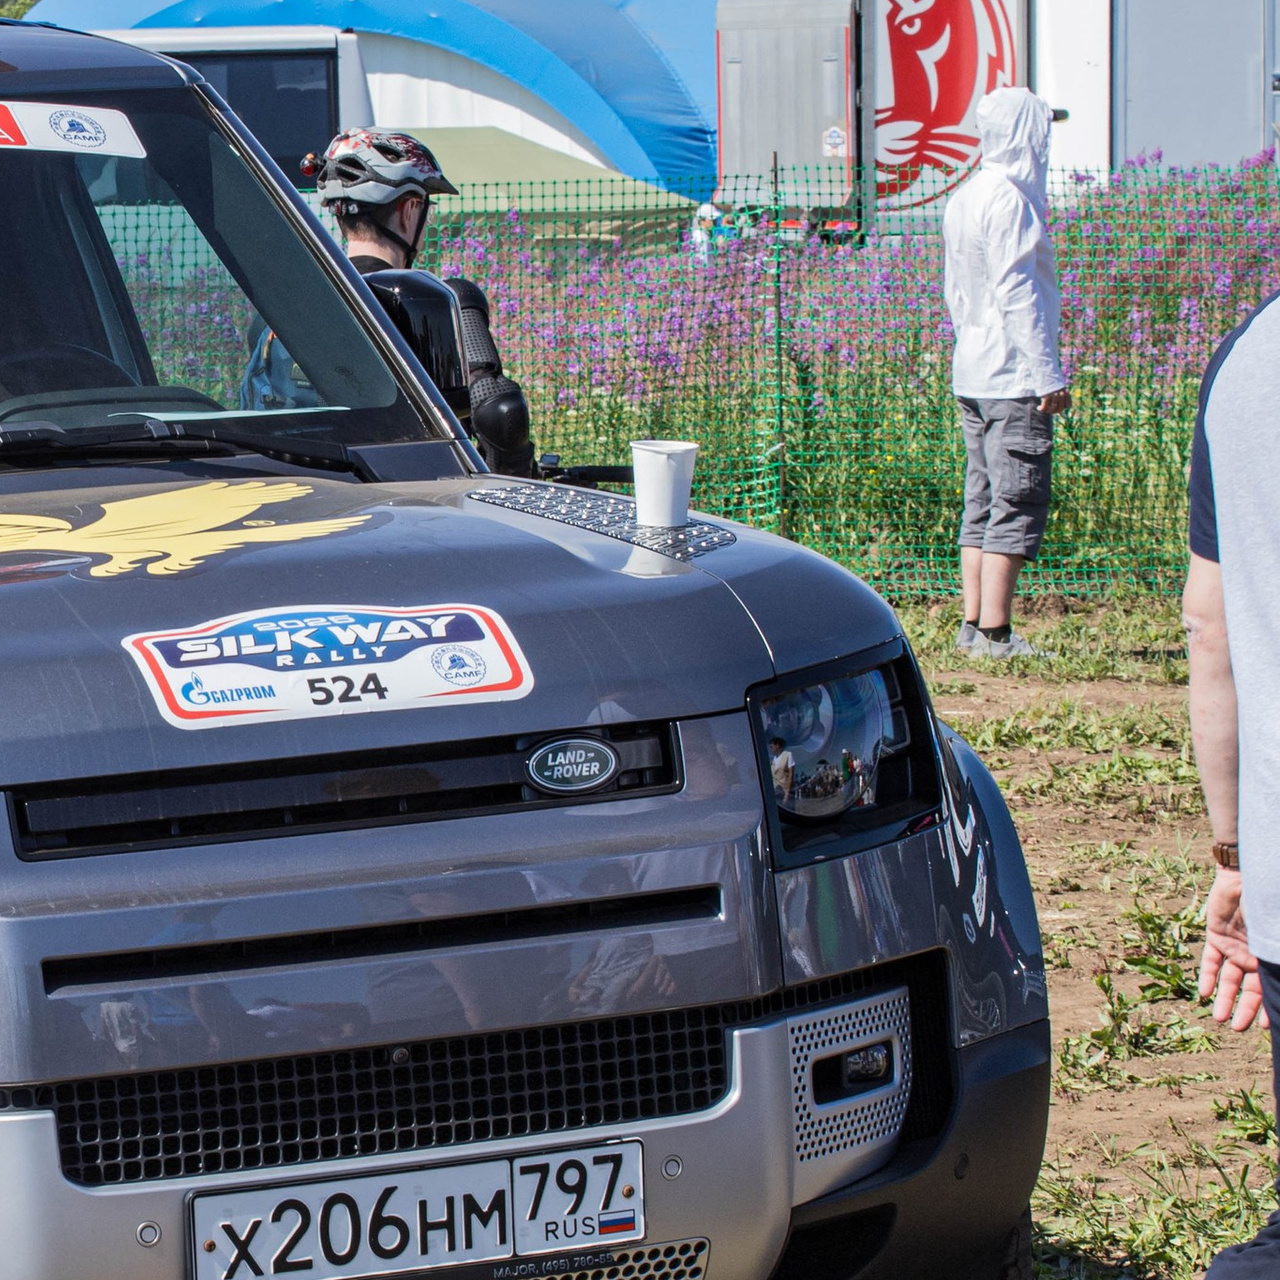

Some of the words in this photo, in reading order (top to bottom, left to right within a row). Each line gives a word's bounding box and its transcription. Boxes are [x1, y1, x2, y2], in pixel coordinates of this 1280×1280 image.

[253, 615, 356, 631] 2025
[176, 628, 324, 662] SILK
[327, 615, 456, 646] WAY
[276, 645, 388, 667] RALLY
[211, 684, 277, 704] GAZPROM
[306, 672, 389, 706] 524
[547, 750, 586, 766] LAND
[553, 762, 600, 779] ROVER
[518, 1153, 624, 1222] 797
[544, 1216, 596, 1241] RUS
